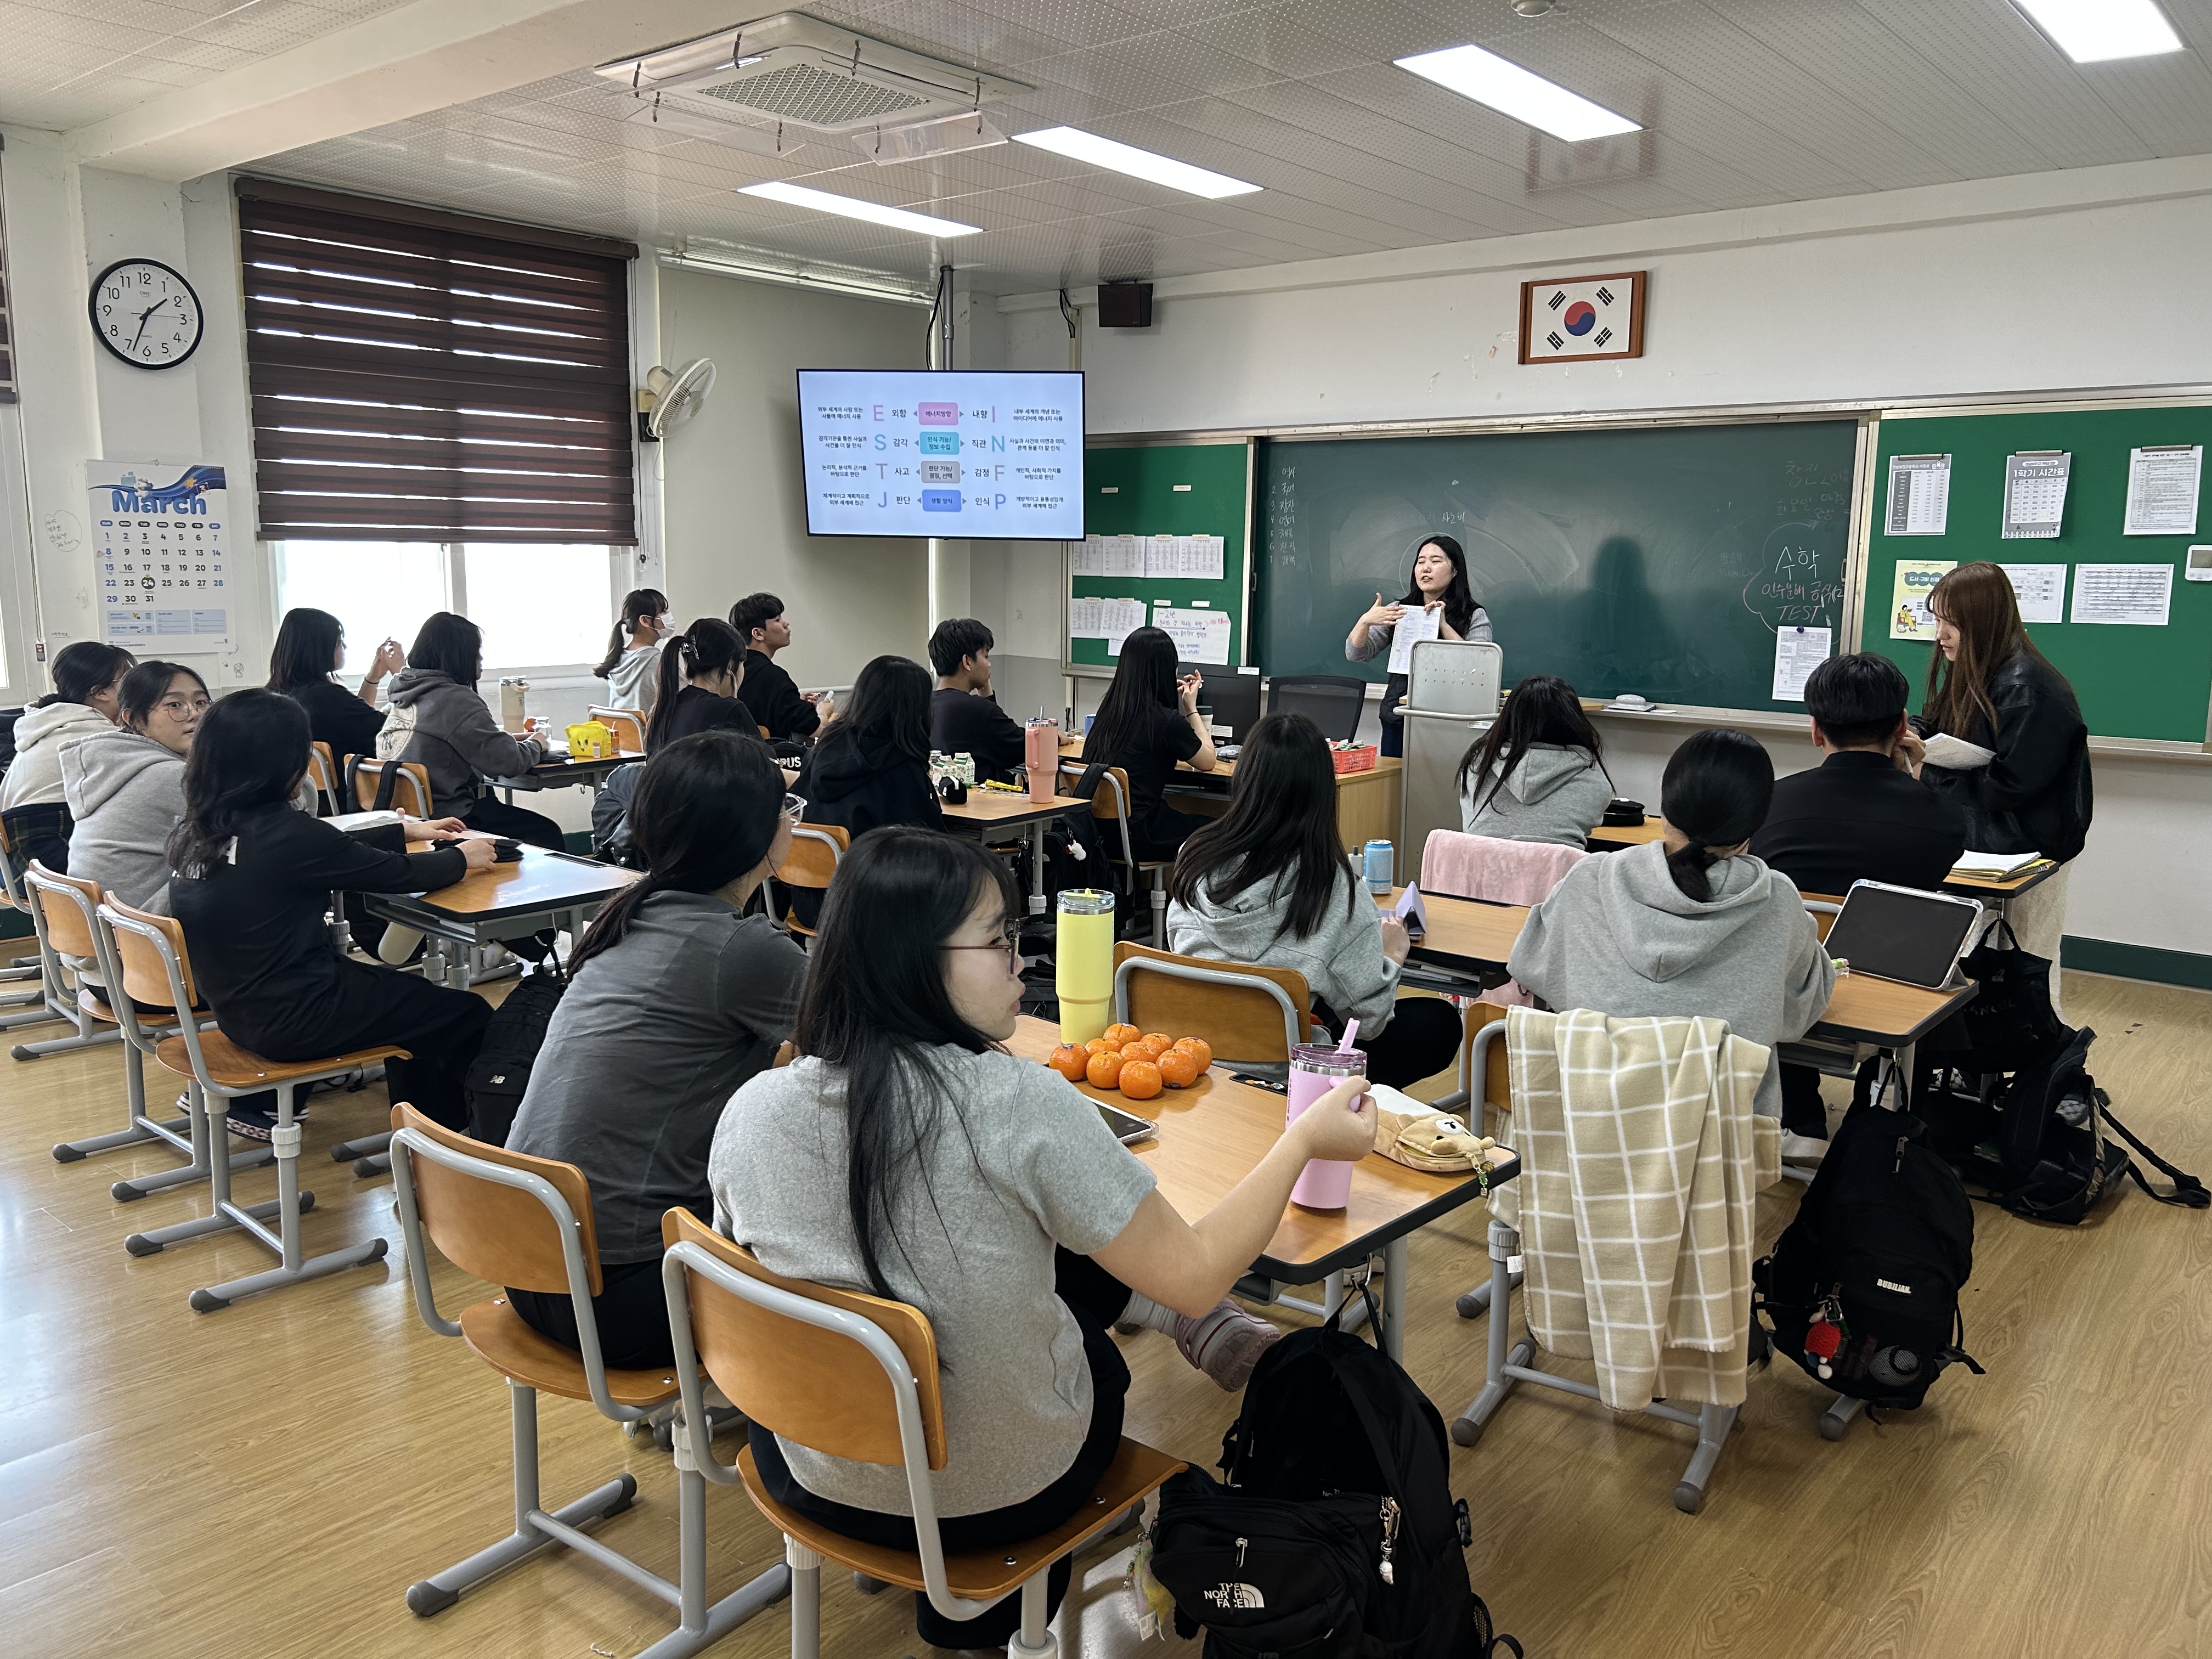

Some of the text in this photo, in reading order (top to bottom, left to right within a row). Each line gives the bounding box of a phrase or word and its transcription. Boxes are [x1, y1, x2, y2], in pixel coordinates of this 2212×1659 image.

[120, 276, 130, 288] 11
[138, 272, 151, 285] 12
[161, 281, 166, 292] 1
[107, 287, 119, 299] 10
[174, 296, 182, 307] 2
[103, 305, 111, 316] 9
[180, 314, 187, 325] 3
[110, 325, 118, 336] 8
[173, 332, 182, 343] 4
[125, 338, 132, 349] 7
[162, 343, 168, 354] 5
[143, 346, 151, 357] 6
[873, 405, 884, 421] E
[892, 409, 906, 417] 외향
[992, 406, 995, 422] I
[875, 434, 886, 450] S
[893, 439, 907, 447] 감각
[972, 439, 986, 448] 직관
[992, 436, 1005, 452] N
[876, 464, 888, 479] T
[895, 467, 910, 476] 사고
[975, 469, 989, 477] 감정
[995, 465, 1005, 481] F
[2013, 467, 2065, 478] 1학기 시간표
[1271, 486, 1276, 494] 2
[112, 490, 206, 515] March
[878, 492, 887, 507] J
[896, 496, 911, 504] 판단
[975, 498, 990, 506] 인식
[995, 494, 1006, 510] P
[1271, 500, 1275, 511] 3
[1271, 515, 1295, 527] 4 영어
[1775, 546, 1820, 581] 수학
[1762, 582, 1805, 600] 인수분해
[1775, 605, 1822, 624] TEST
[1204, 1590, 1243, 1599] NORH
